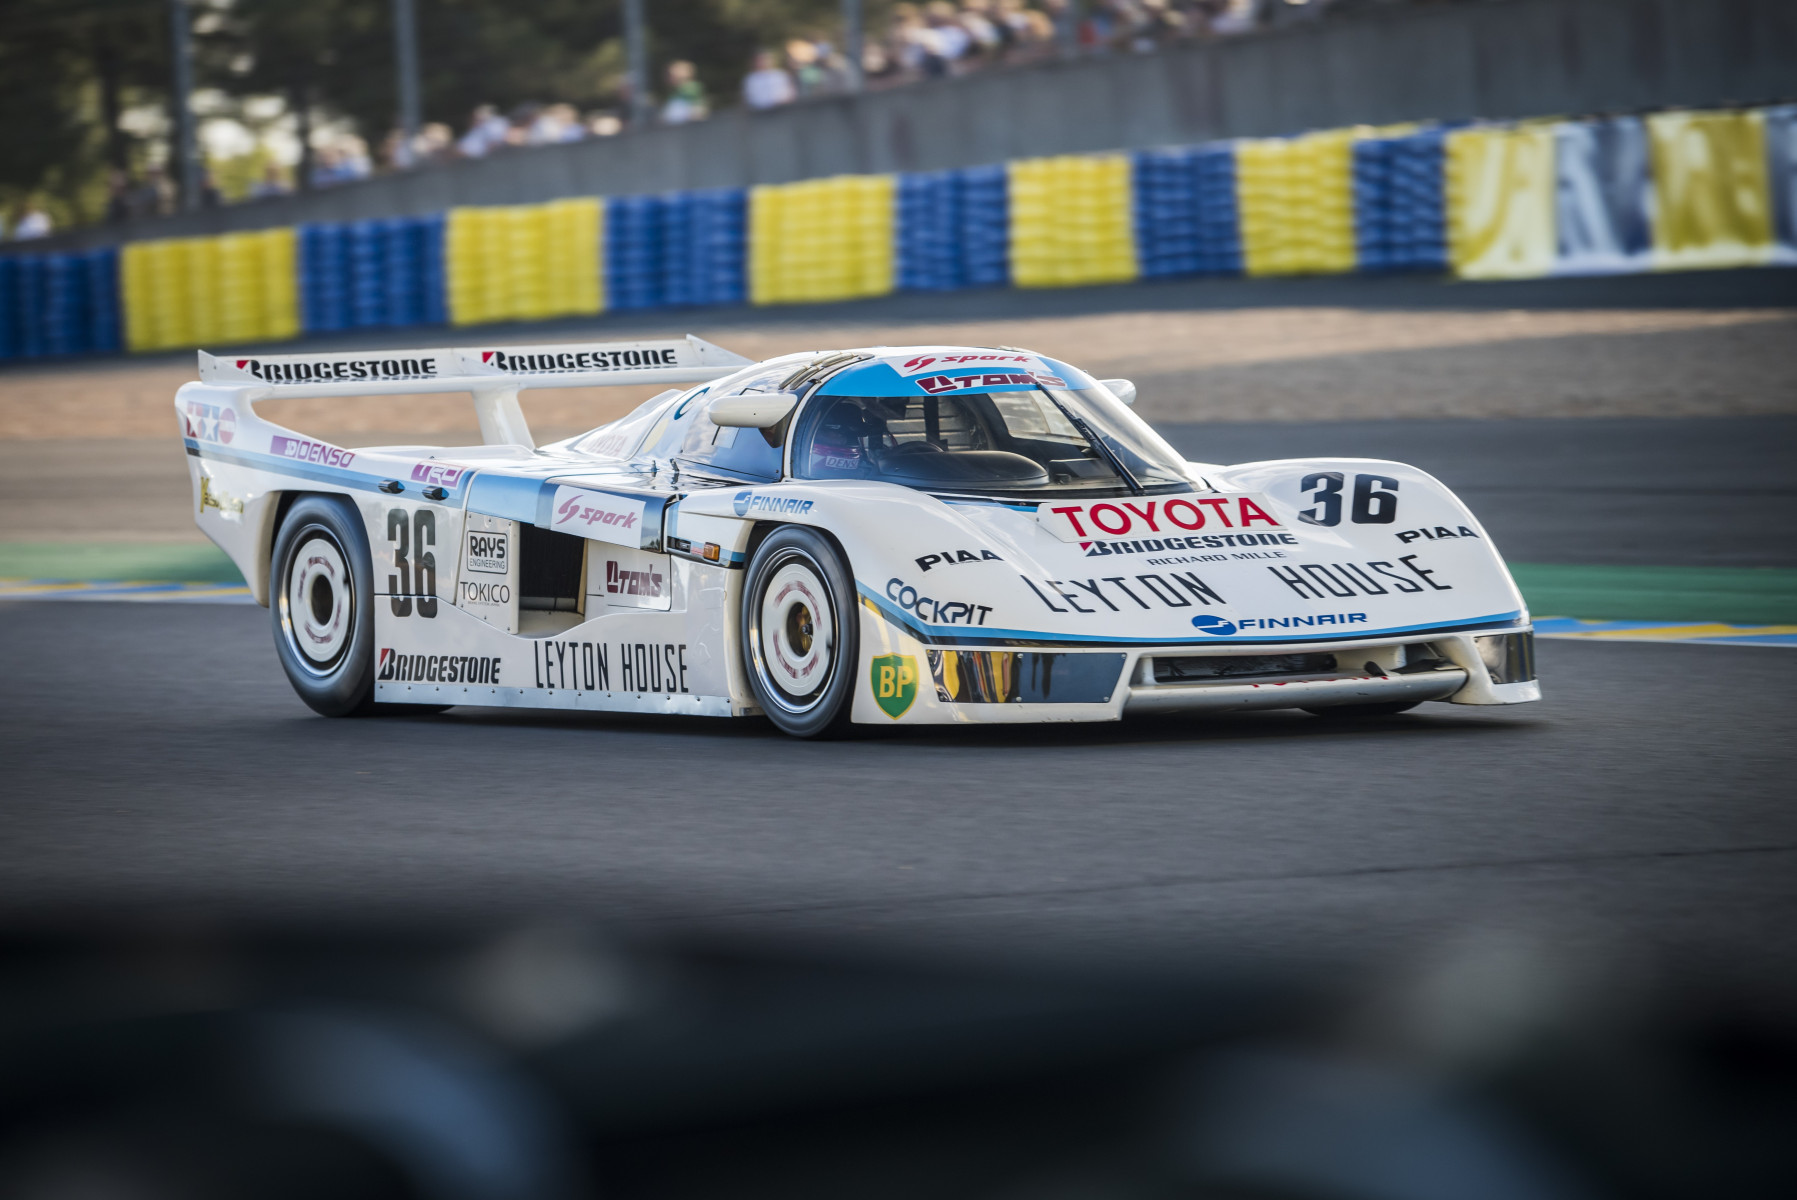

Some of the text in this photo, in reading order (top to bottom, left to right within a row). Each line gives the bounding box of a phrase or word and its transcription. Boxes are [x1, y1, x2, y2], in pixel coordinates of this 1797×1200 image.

[493, 349, 678, 371] BRIDGESTONE
[941, 355, 1031, 363] spark
[297, 440, 356, 468] DENSO
[827, 457, 859, 469] DENS
[749, 495, 814, 515] FINNAIR
[1297, 471, 1399, 527] 36
[580, 507, 638, 529] spark
[1051, 497, 1281, 537] TOYOTA
[1085, 533, 1299, 557] BRIDGESTONE
[1395, 526, 1480, 544] PIAA
[470, 536, 505, 559] RAYS
[1146, 550, 1288, 566] RICHARD MILLE
[387, 508, 438, 619] 36
[470, 558, 505, 570] ENGINEERING
[915, 549, 1004, 572] PIAA
[460, 581, 510, 604] TOKICO
[619, 564, 662, 598] TOM'S
[1020, 554, 1453, 613] LEYTON HOUSE
[886, 577, 993, 626] COCKPIT
[1238, 612, 1368, 630] FINNAIR
[378, 648, 502, 684] BRIDGESTONE
[534, 640, 688, 694] LEYTON HOUSE
[879, 664, 914, 699] BP
